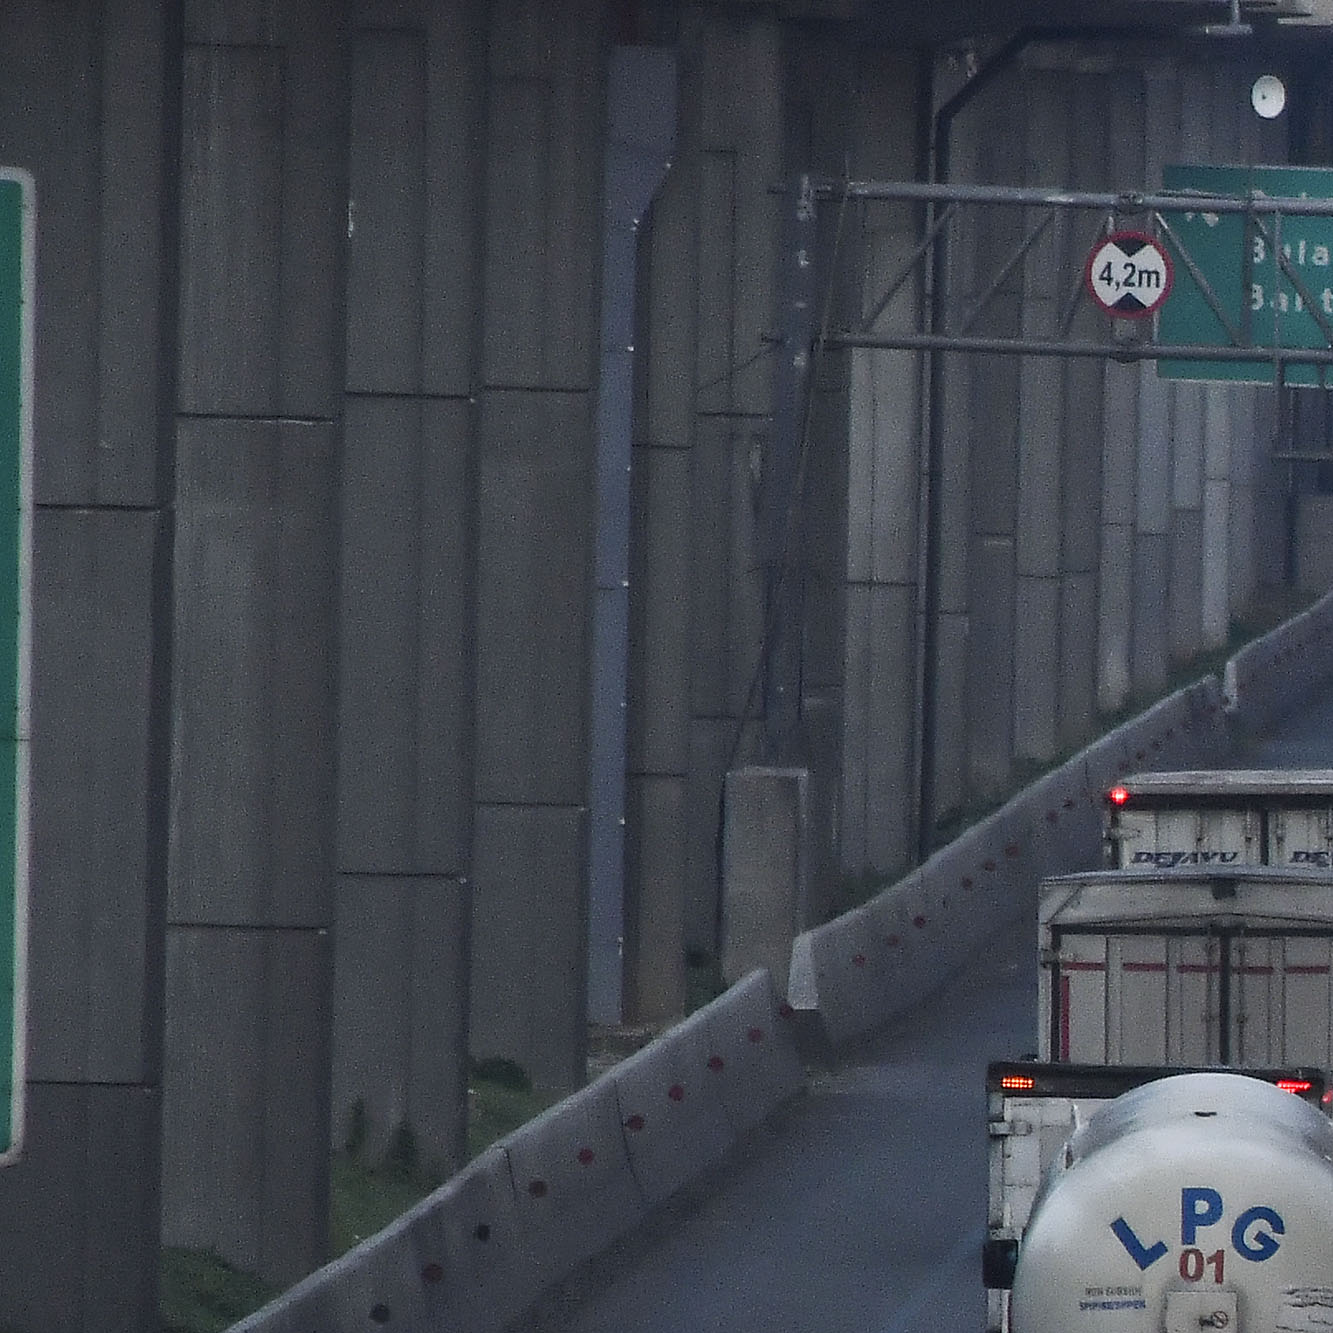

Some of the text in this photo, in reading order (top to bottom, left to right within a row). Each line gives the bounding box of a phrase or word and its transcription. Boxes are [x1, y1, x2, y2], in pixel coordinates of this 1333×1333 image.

[1099, 261, 1161, 289] 4,2m
[1109, 1187, 1286, 1271] LPG
[1178, 1248, 1225, 1285] 01
